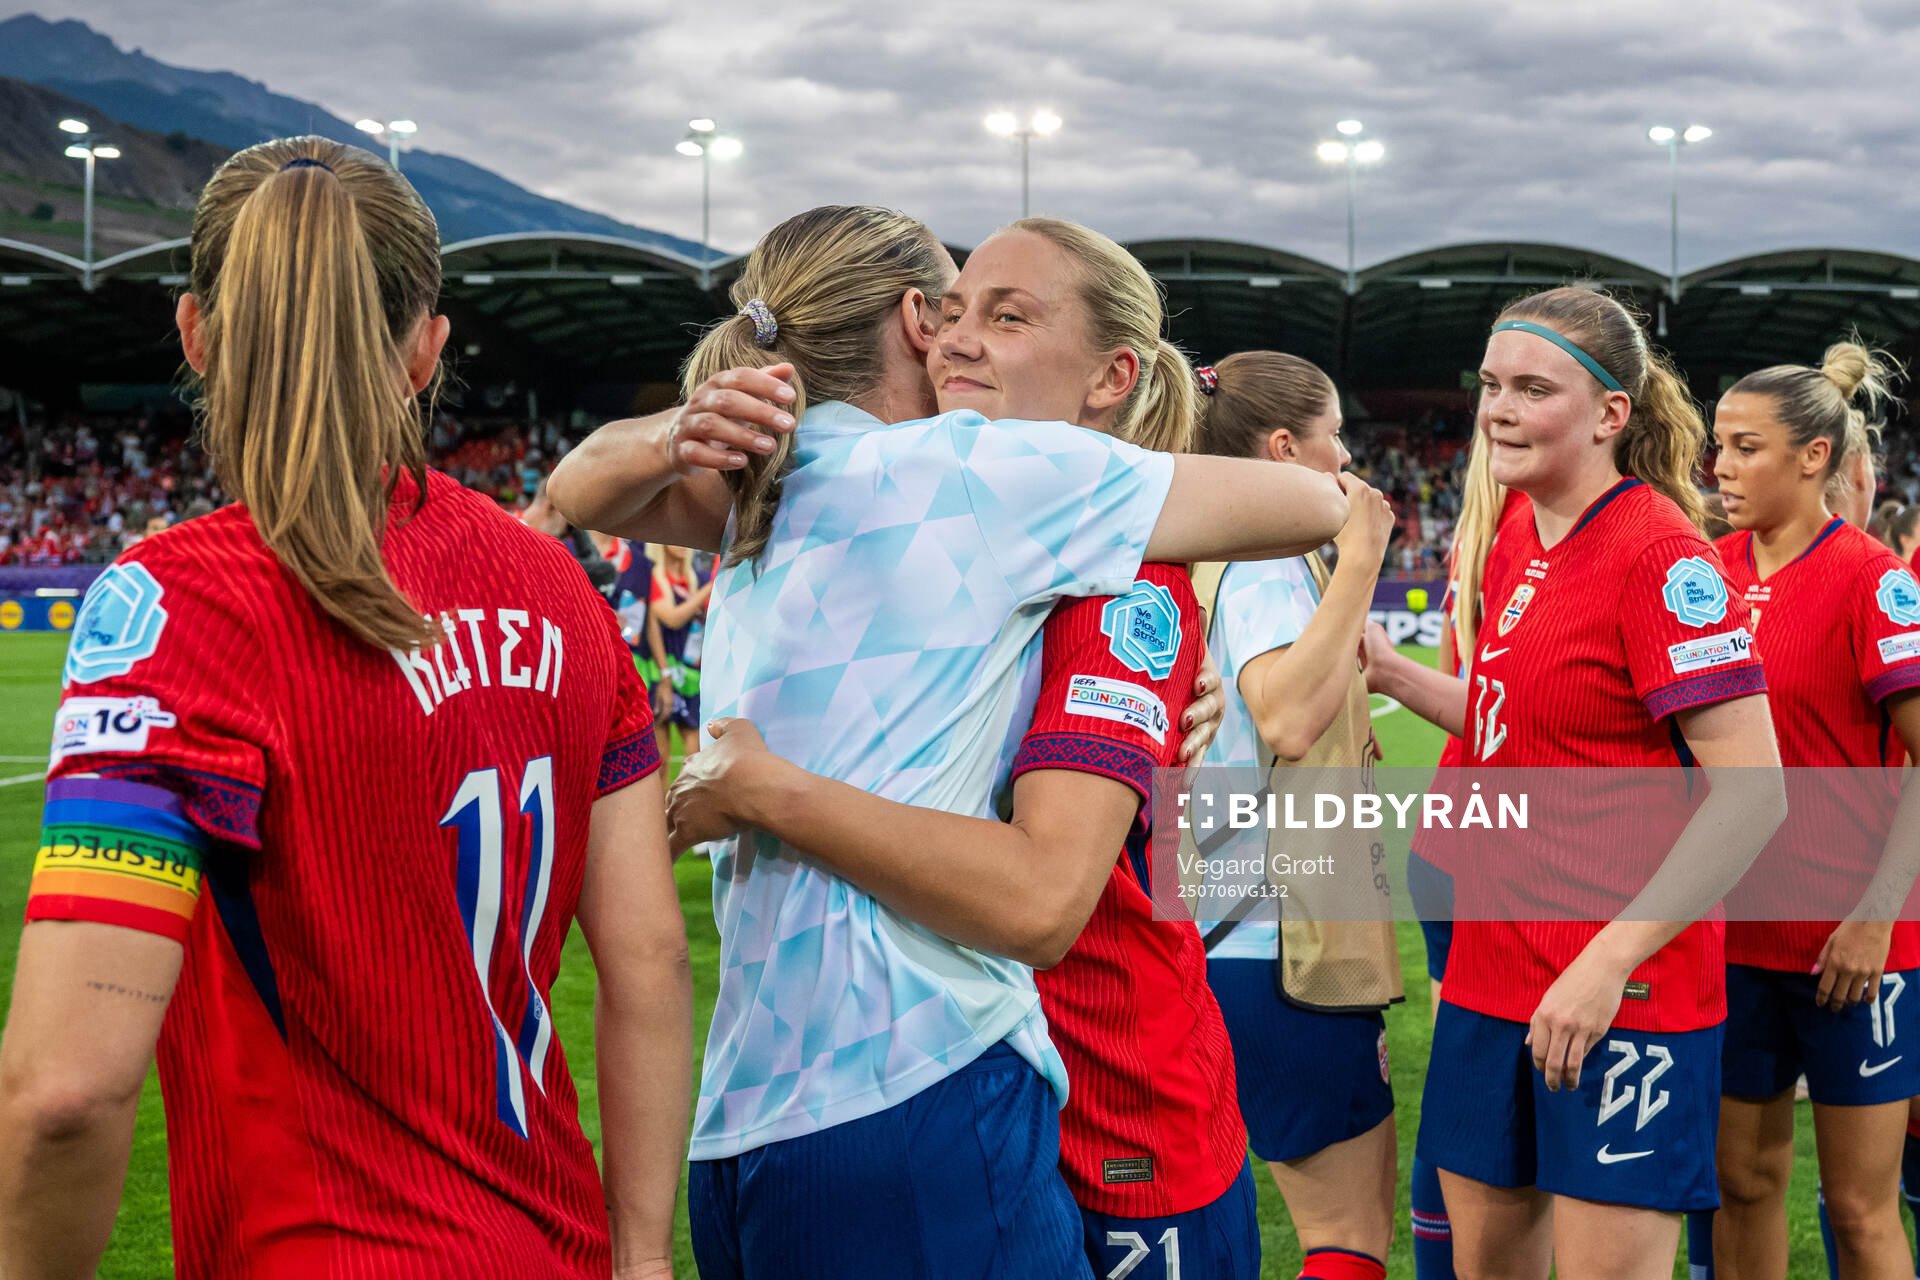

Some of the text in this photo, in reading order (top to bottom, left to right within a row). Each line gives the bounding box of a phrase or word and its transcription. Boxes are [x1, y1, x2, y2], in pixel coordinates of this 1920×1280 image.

[1136, 607, 1152, 620] We
[1134, 617, 1157, 635] Play
[1133, 627, 1166, 651] Strong
[1673, 644, 1730, 663] FOUNDATION
[1073, 677, 1096, 687] UEFA
[1071, 688, 1152, 717] FOUNDATION
[95, 709, 142, 734] 10
[45, 834, 189, 877] RESPECT
[439, 755, 555, 1140] 11
[1597, 1039, 1674, 1132] 22
